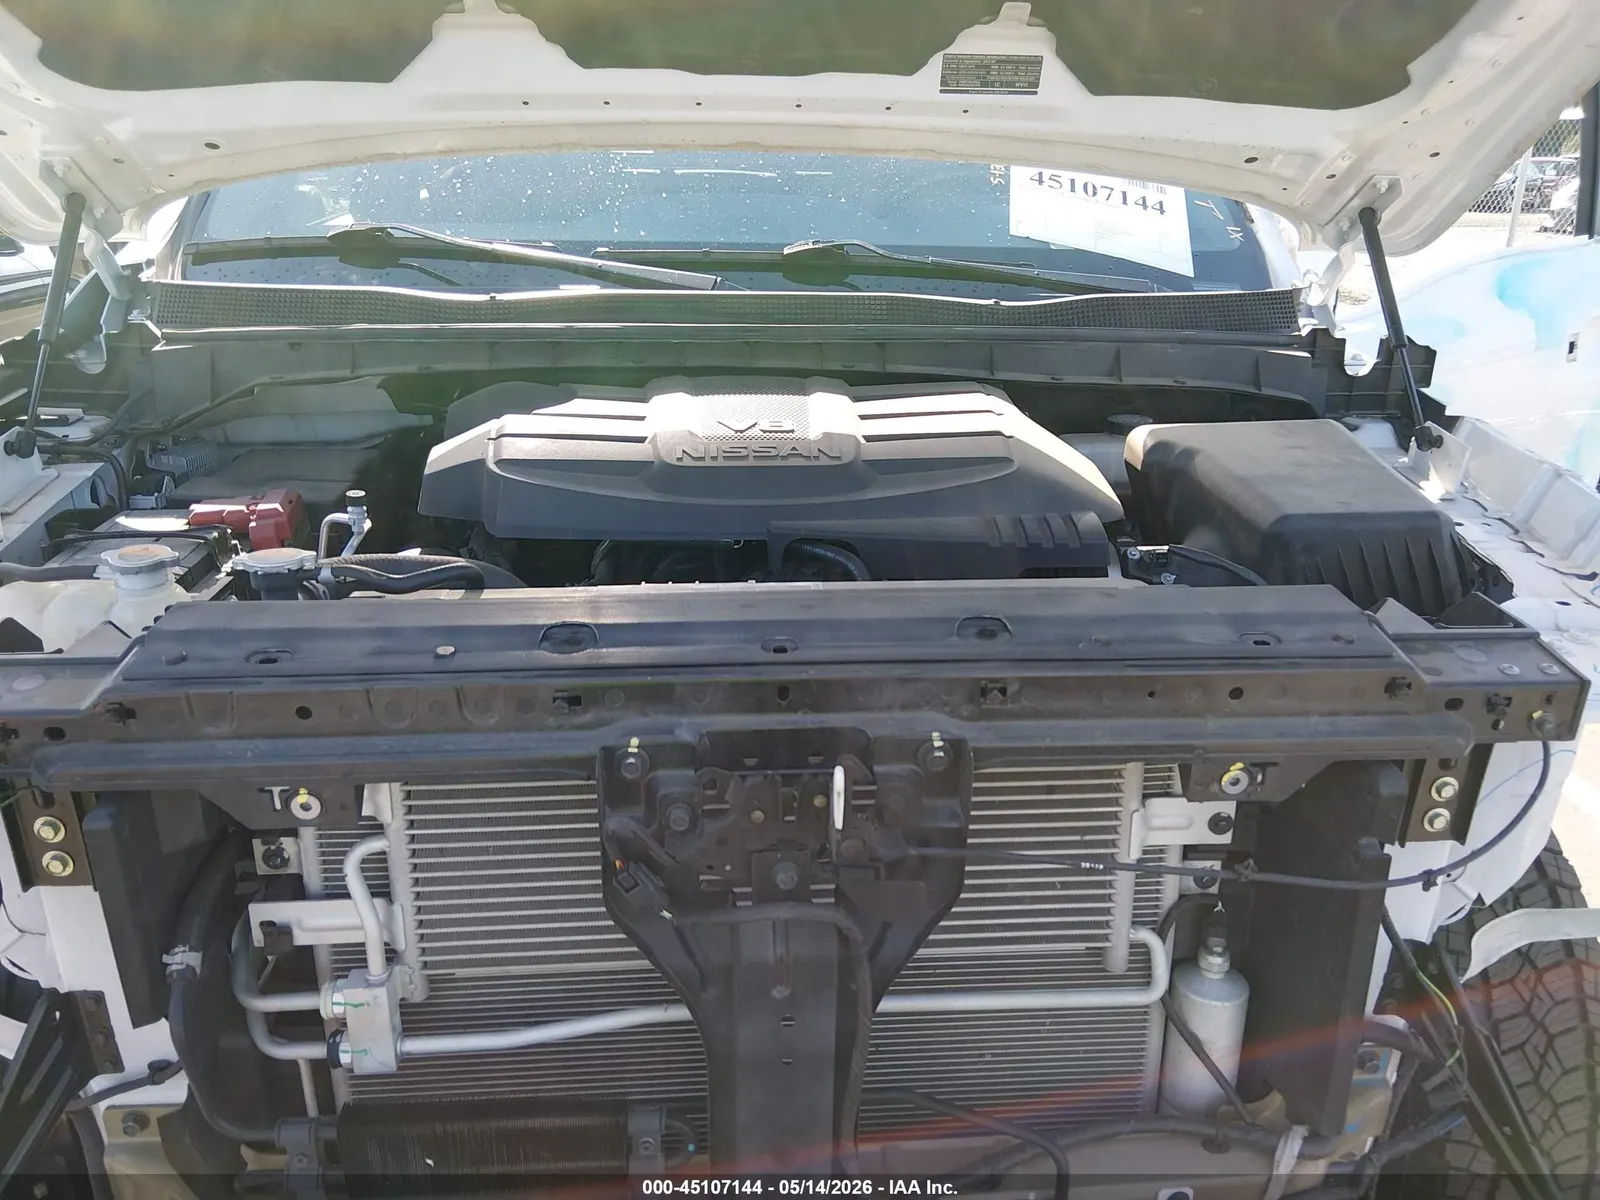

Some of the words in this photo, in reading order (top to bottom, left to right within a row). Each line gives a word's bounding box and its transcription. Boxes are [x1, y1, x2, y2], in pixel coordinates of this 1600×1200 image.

[1029, 170, 1167, 216] 45107144
[717, 418, 796, 434] V8
[674, 443, 842, 462] NISSAN
